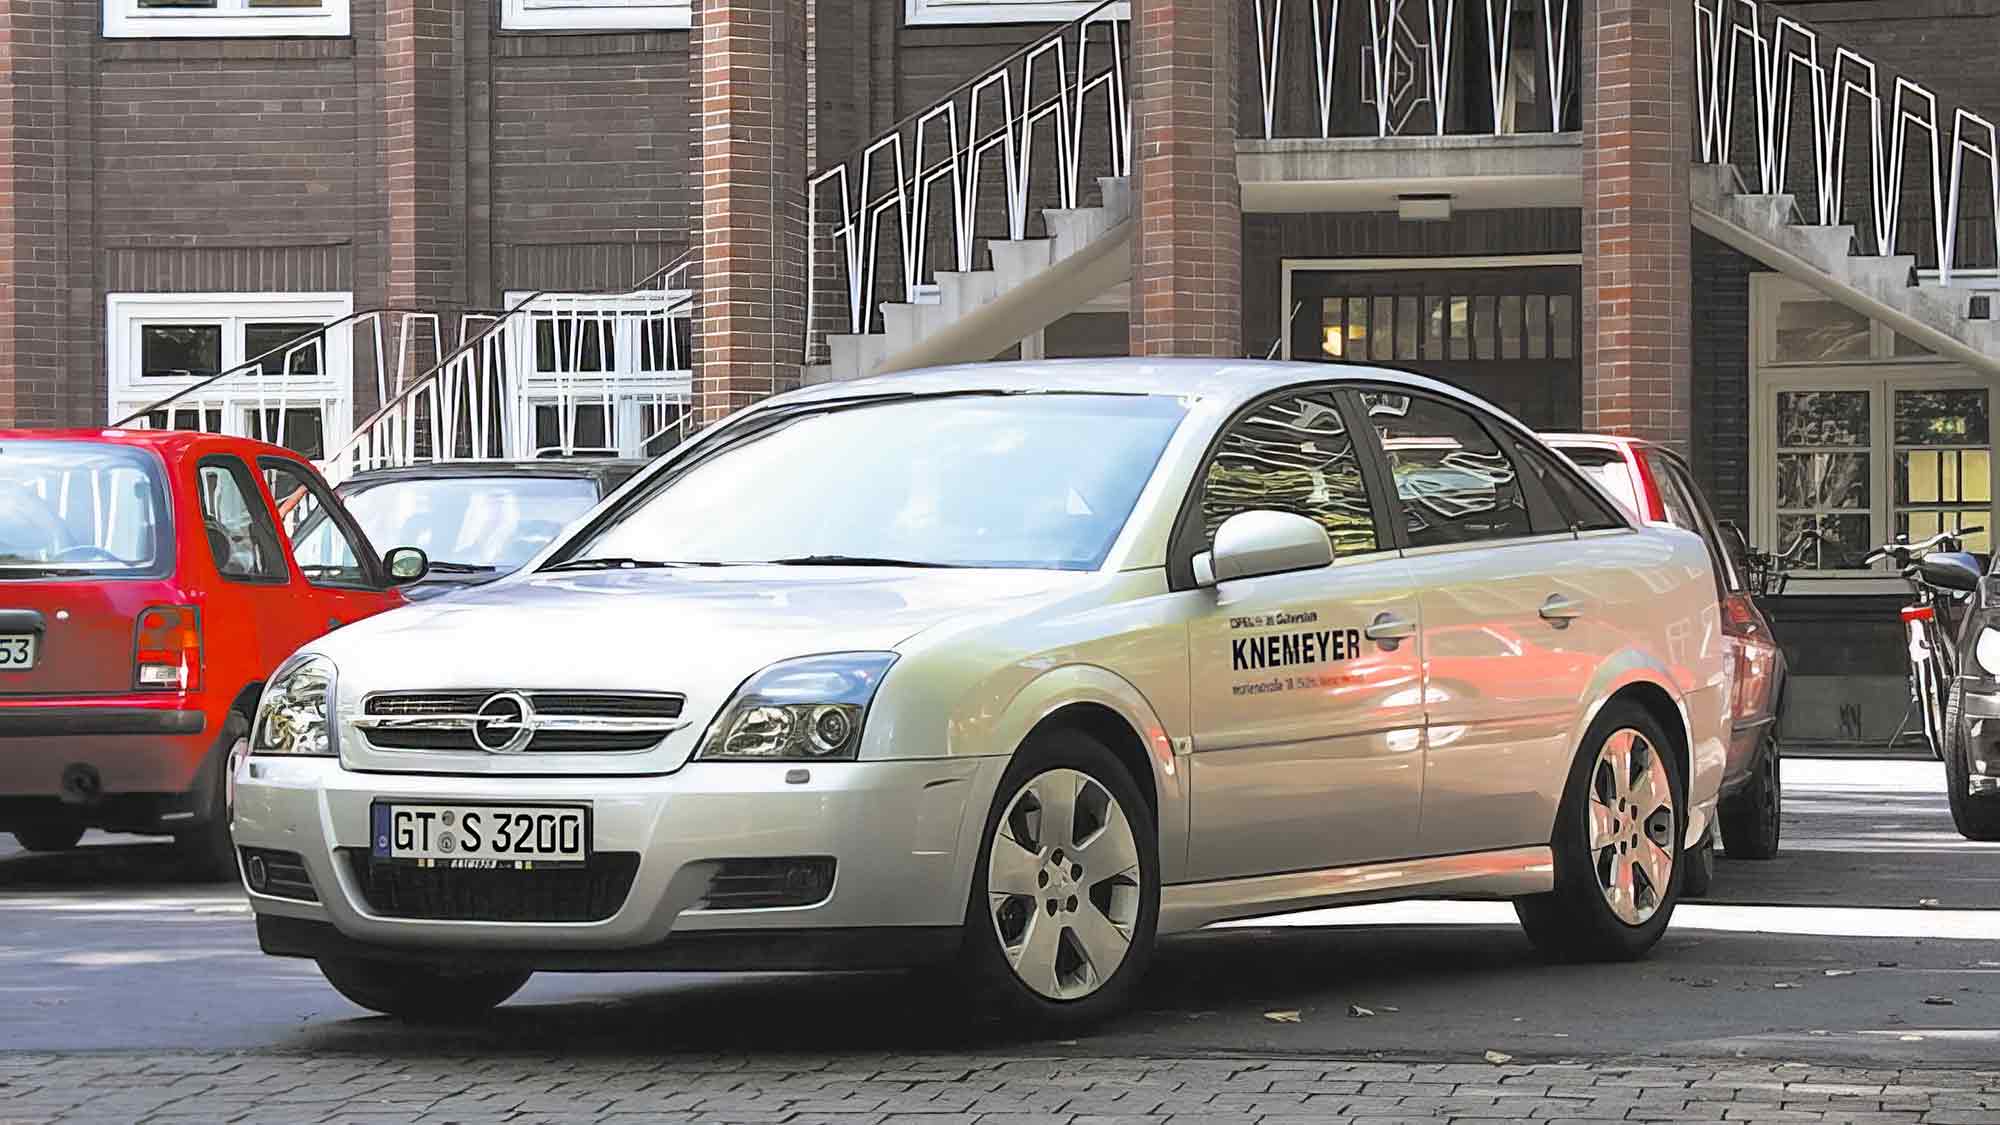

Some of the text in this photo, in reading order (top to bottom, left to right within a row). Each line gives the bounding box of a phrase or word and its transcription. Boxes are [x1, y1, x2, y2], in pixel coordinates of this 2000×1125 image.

[1232, 629, 1360, 671] KNEMEYER
[394, 811, 579, 854] GT S 3200
